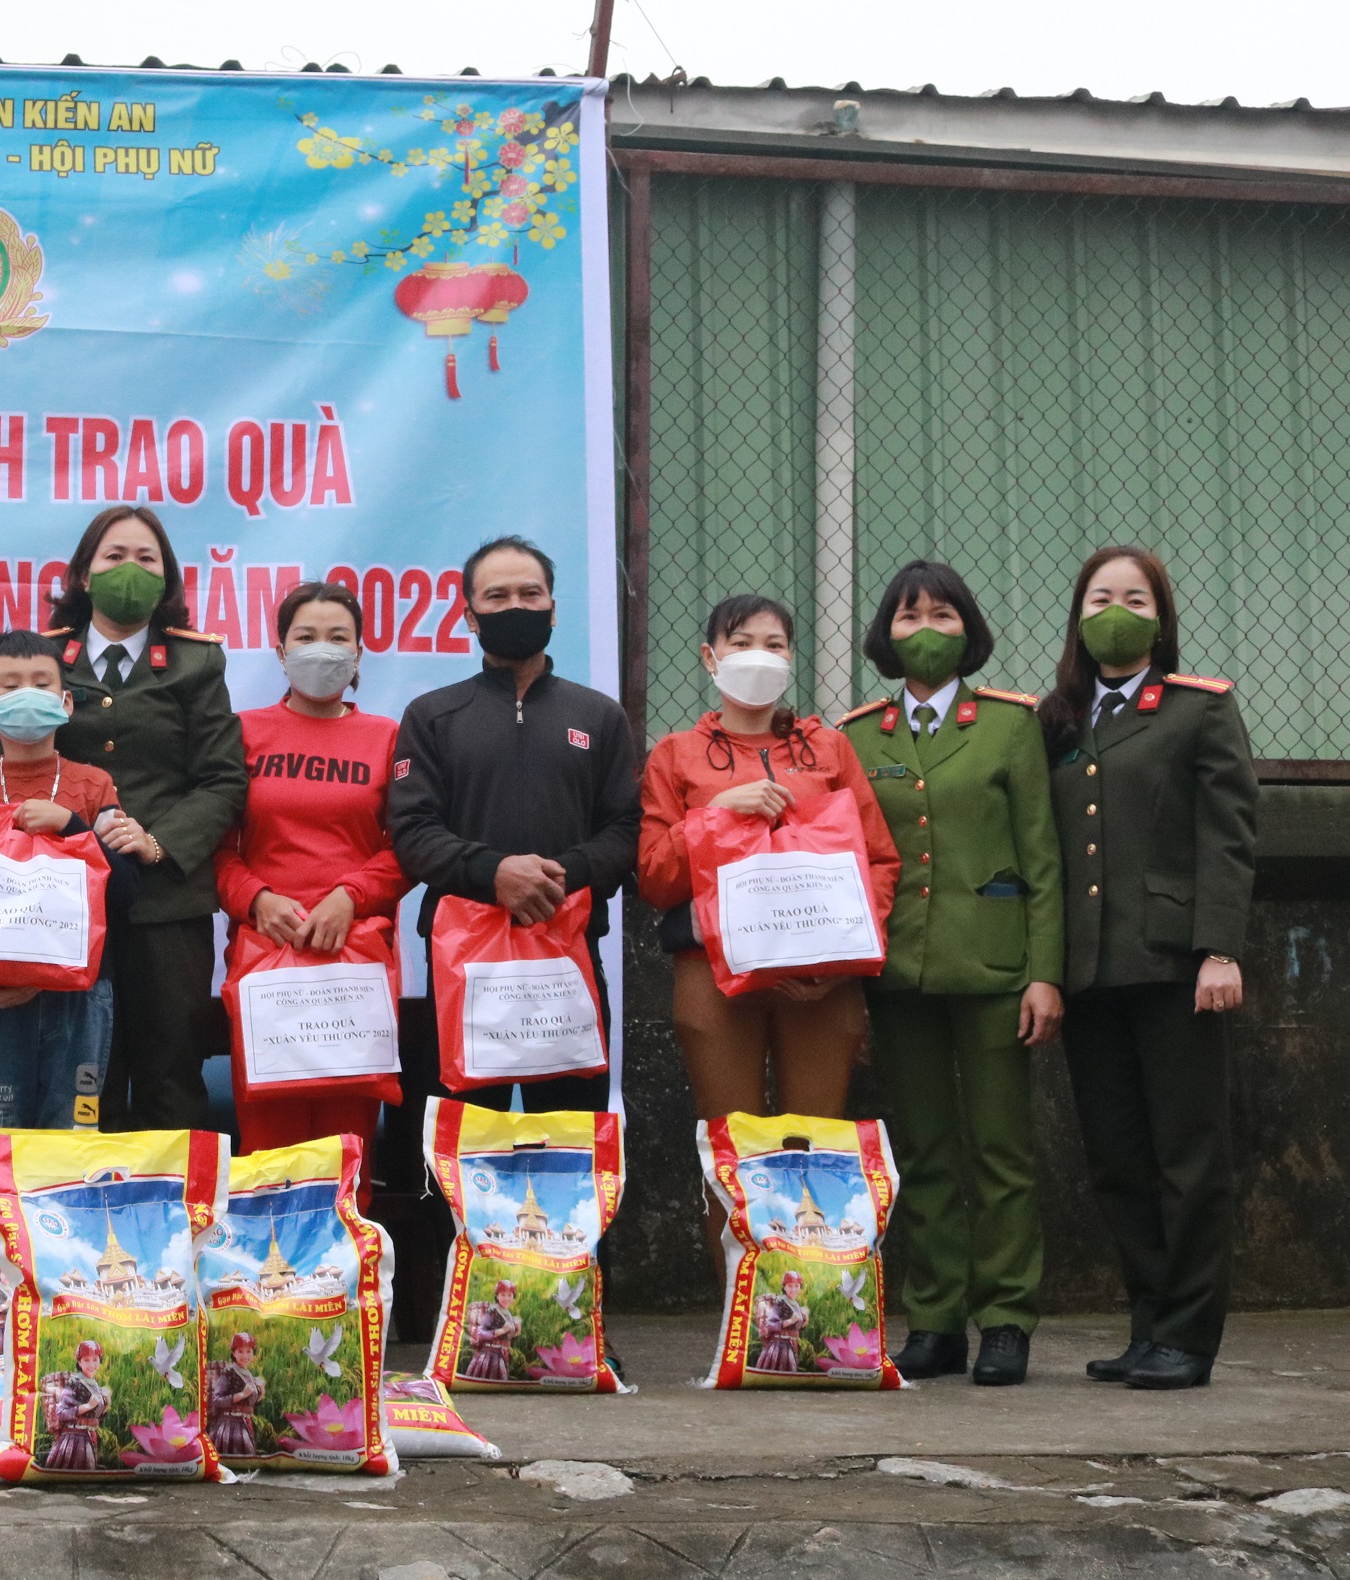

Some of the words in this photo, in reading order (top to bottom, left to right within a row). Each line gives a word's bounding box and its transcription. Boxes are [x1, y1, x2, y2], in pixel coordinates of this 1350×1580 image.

[23, 90, 100, 131] KIẾN
[108, 103, 156, 132] AN
[7, 153, 22, 163] -
[30, 139, 85, 178] HỘI
[95, 145, 162, 179] PHỤ
[169, 142, 220, 177] NỮ
[46, 416, 206, 505] TRAO
[227, 405, 352, 517] QUÀ
[19, 902, 43, 914] QUÀ
[771, 908, 802, 918] TRAO
[804, 902, 829, 915] QUÀ
[59, 921, 79, 931] 2022
[774, 920, 793, 931] YÊU
[845, 917, 864, 925] 2022
[298, 1020, 329, 1031] TRAO
[332, 1016, 356, 1029] QUÀ
[520, 1017, 548, 1026] TRAO
[299, 1032, 320, 1043] YÊU
[373, 1030, 390, 1038] 2022
[520, 1029, 539, 1039] YÊU
[450, 1282, 463, 1318] LÀI
[735, 1279, 748, 1312] LÀI
[292, 1302, 313, 1313] LÀI
[315, 1300, 343, 1313] MIÊN
[17, 1283, 33, 1349] THƠM
[135, 1311, 155, 1324] LÀI
[157, 1310, 186, 1324] MIÊN
[363, 1289, 380, 1357] THƠM
[438, 1320, 458, 1370] MIÊN
[725, 1315, 743, 1364] MIÊN
[17, 1354, 32, 1397] LÀI
[392, 1406, 448, 1424] MIÊN
